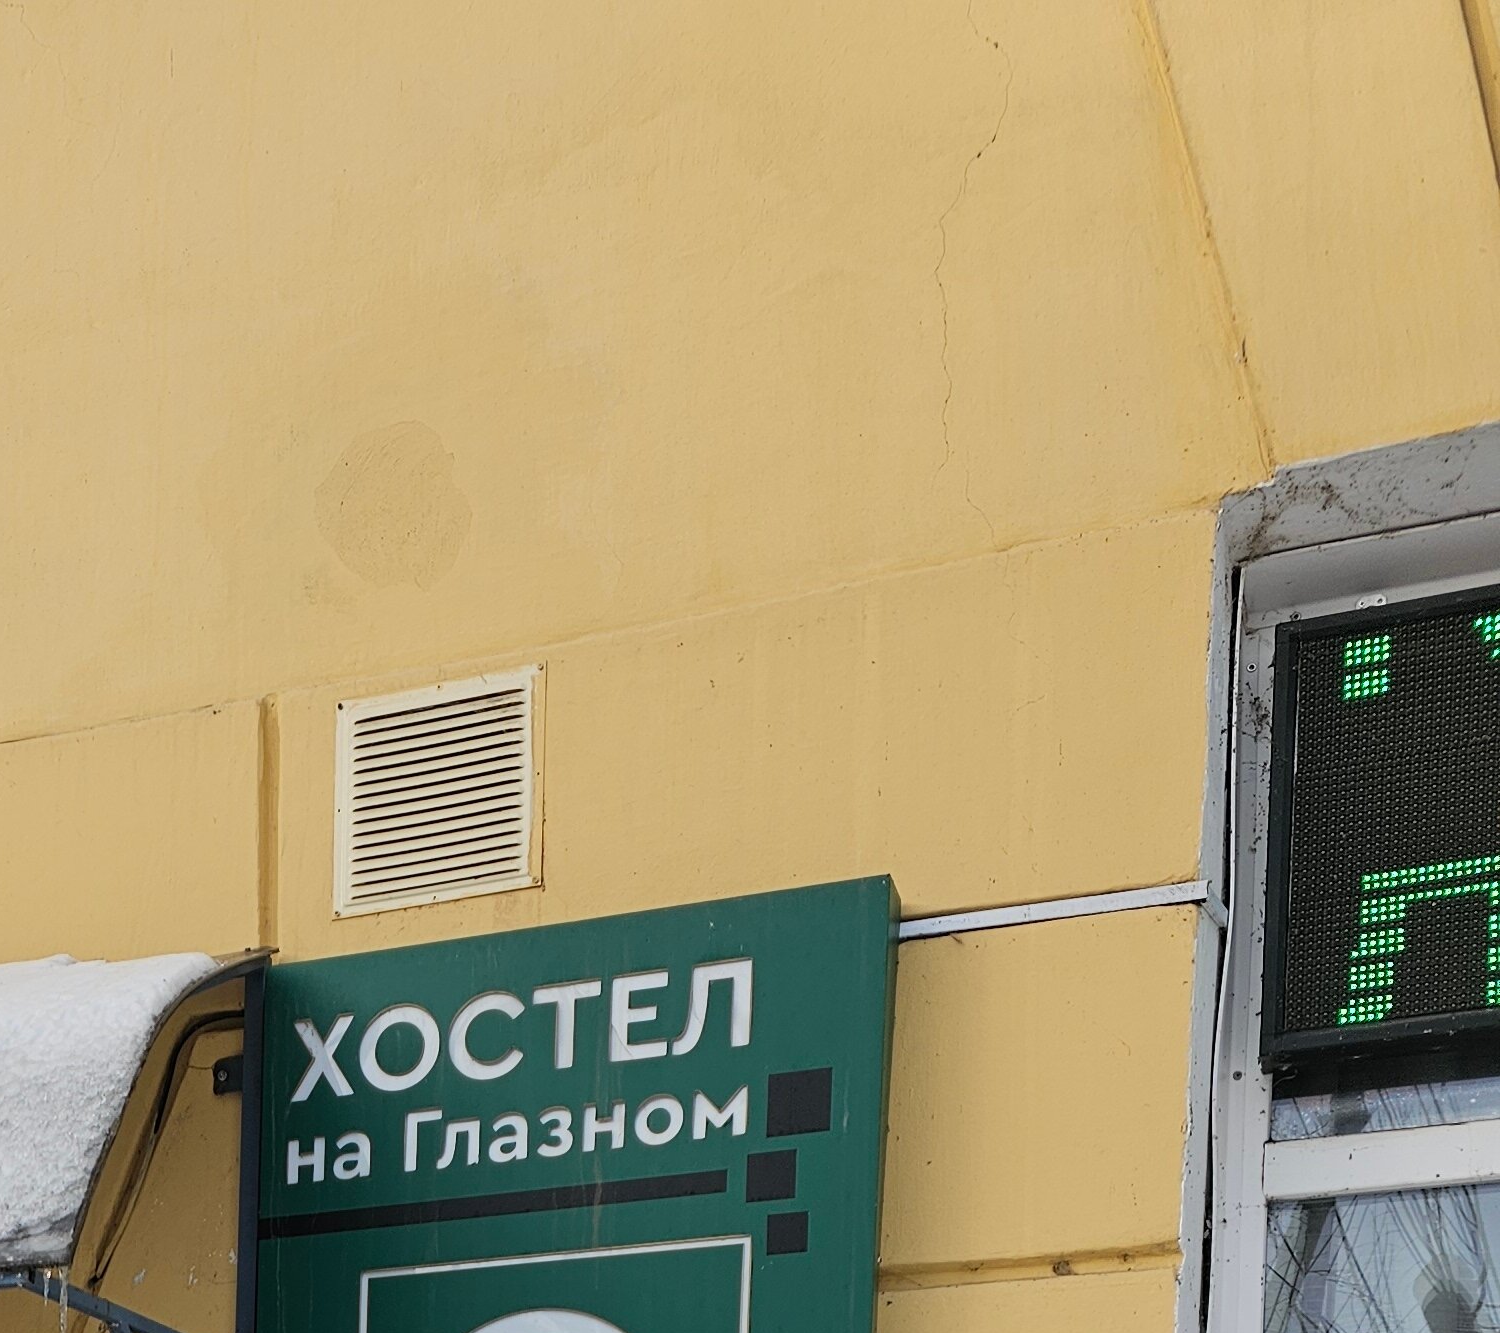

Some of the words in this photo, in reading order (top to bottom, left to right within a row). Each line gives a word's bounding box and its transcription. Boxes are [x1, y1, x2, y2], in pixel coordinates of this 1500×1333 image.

[290, 957, 754, 1103] ХОСТЕЛ
[286, 1132, 372, 1185] на
[403, 1085, 749, 1173] Глазном
